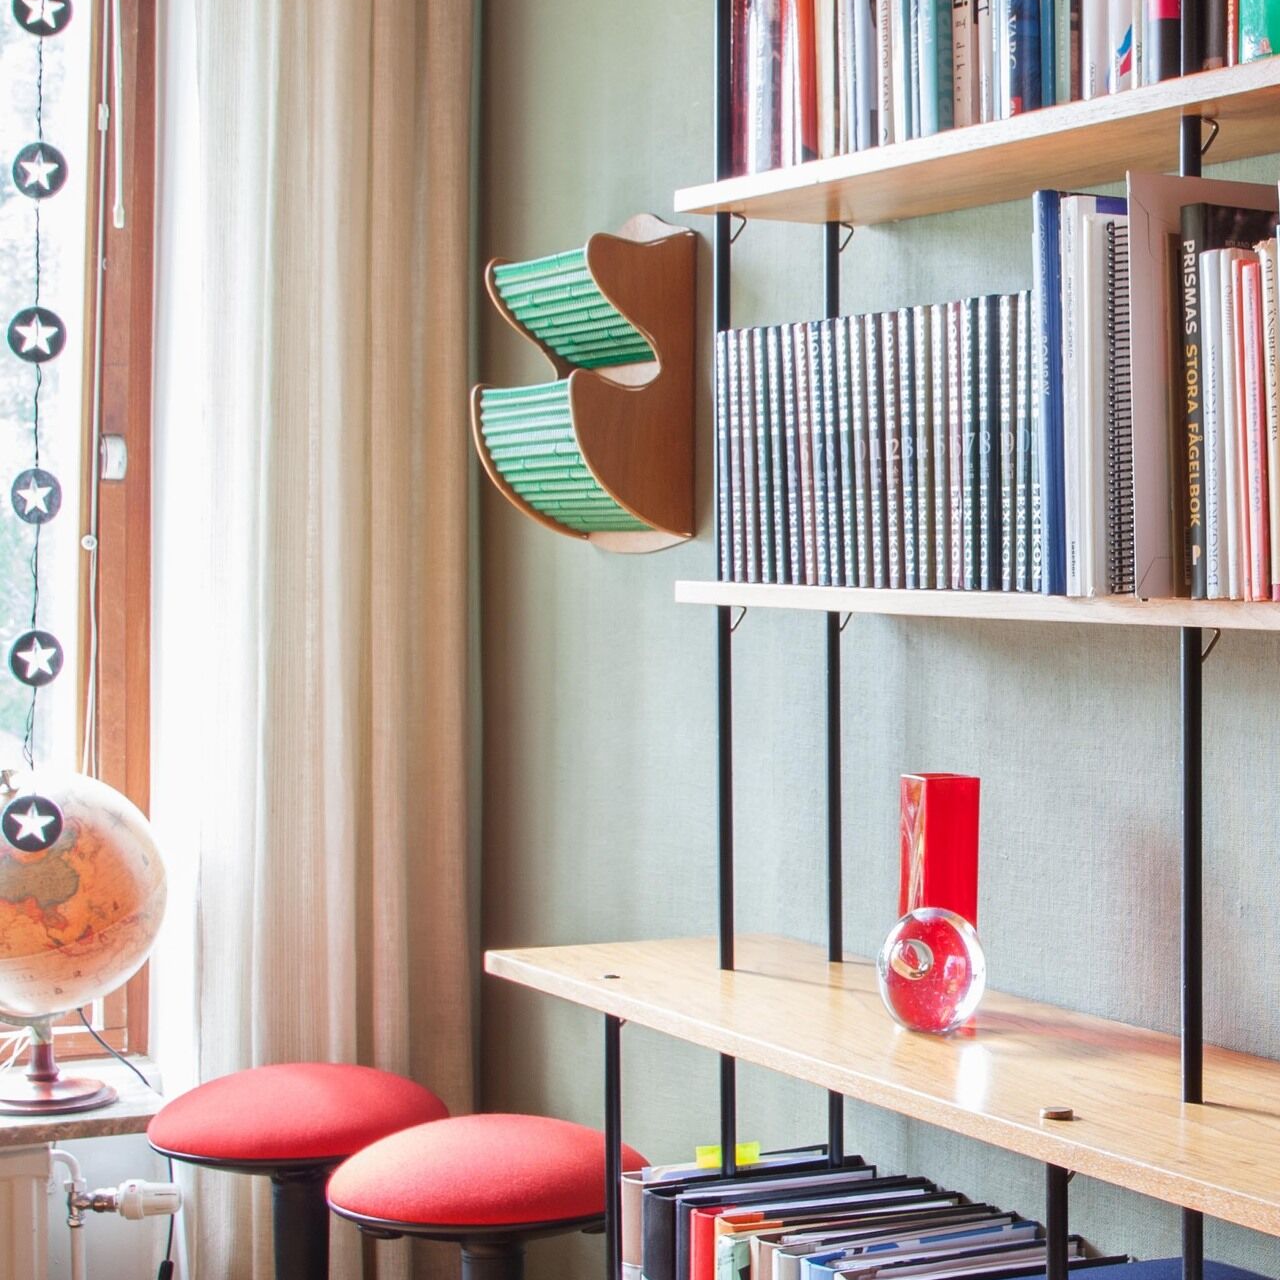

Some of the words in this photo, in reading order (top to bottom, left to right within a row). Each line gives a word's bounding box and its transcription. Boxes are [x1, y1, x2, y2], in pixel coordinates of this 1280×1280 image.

[1183, 239, 1198, 335] PRISMAS
[1185, 343, 1199, 414] STORA
[1186, 422, 1203, 526] FÅGELBOK
